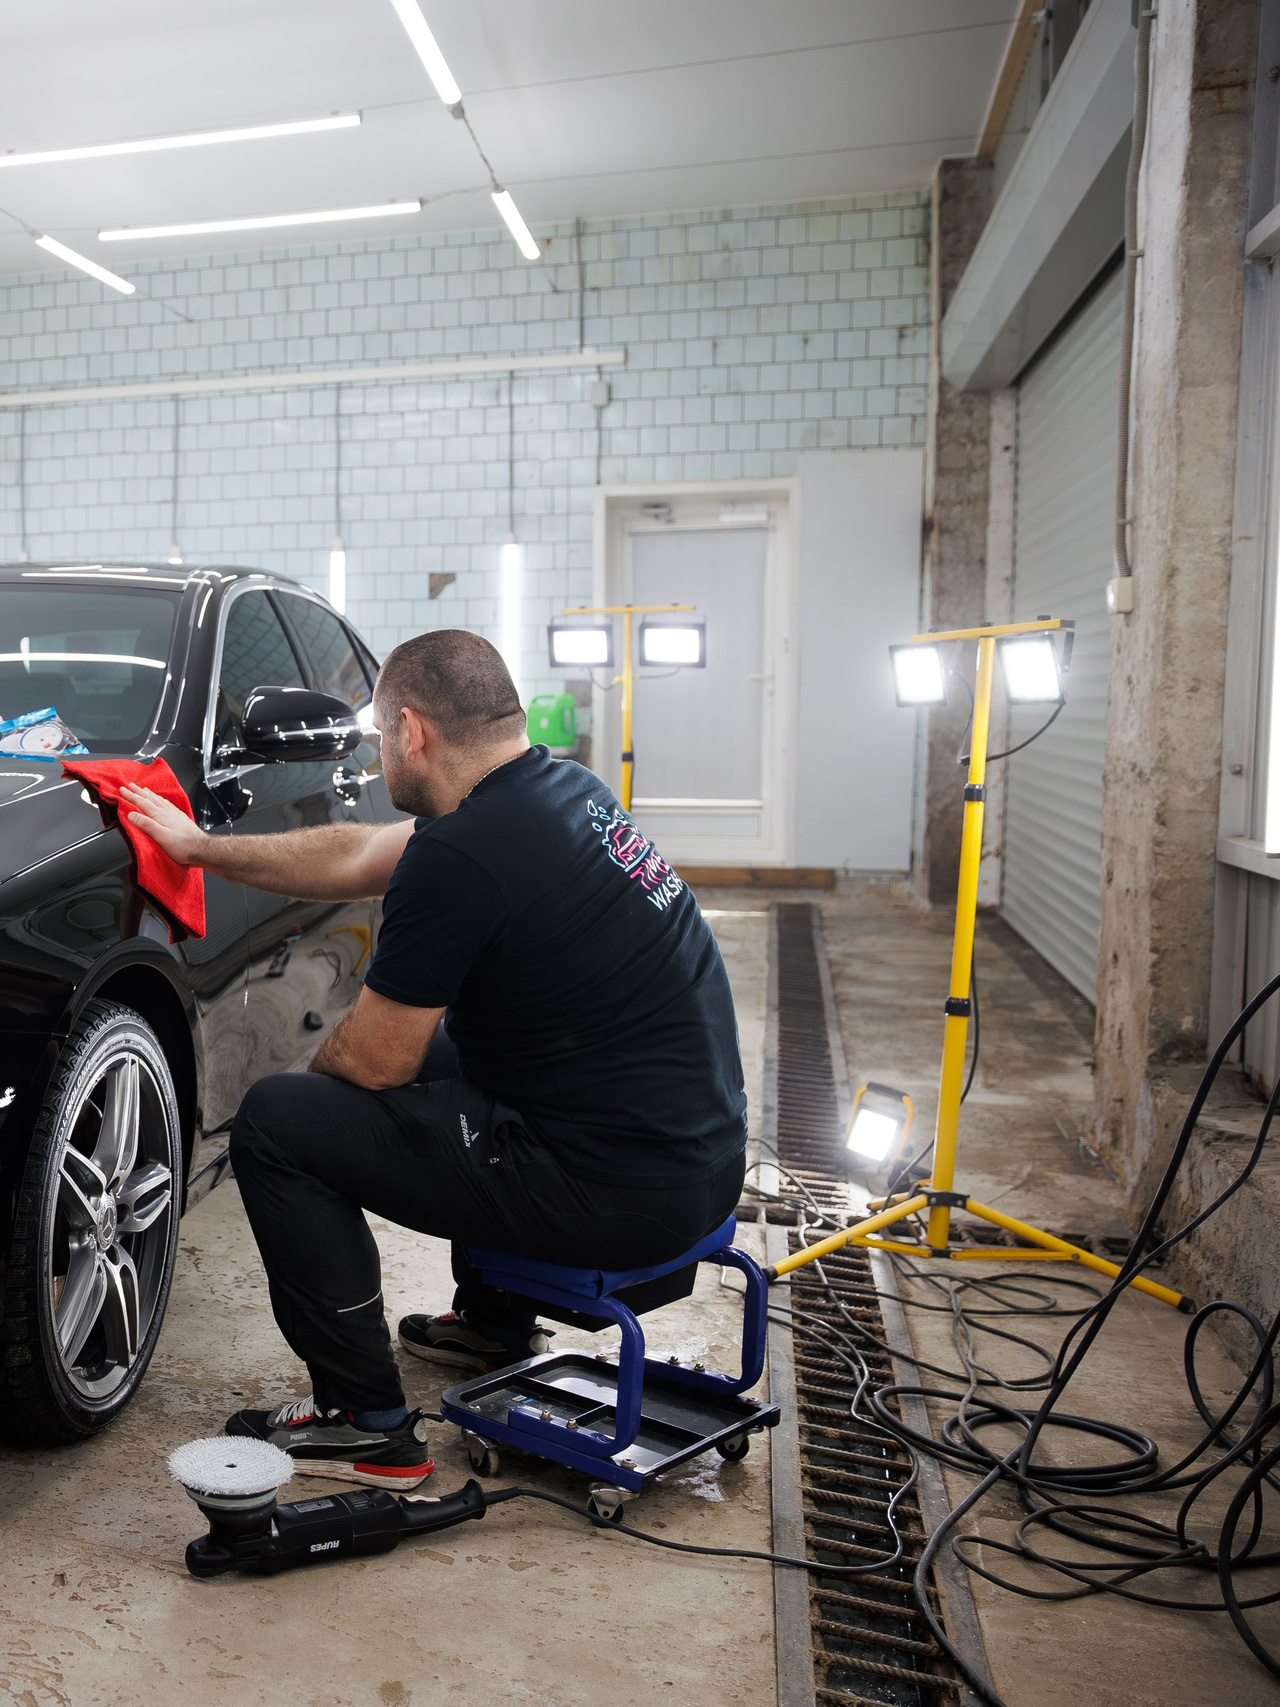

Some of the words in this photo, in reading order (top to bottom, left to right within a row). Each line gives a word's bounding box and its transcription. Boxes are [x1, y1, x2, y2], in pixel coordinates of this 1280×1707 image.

[647, 874, 684, 910] WASH
[459, 1113, 471, 1148] DEMIX
[290, 1432, 307, 1441] PUMA
[310, 1539, 340, 1552] RUPES
